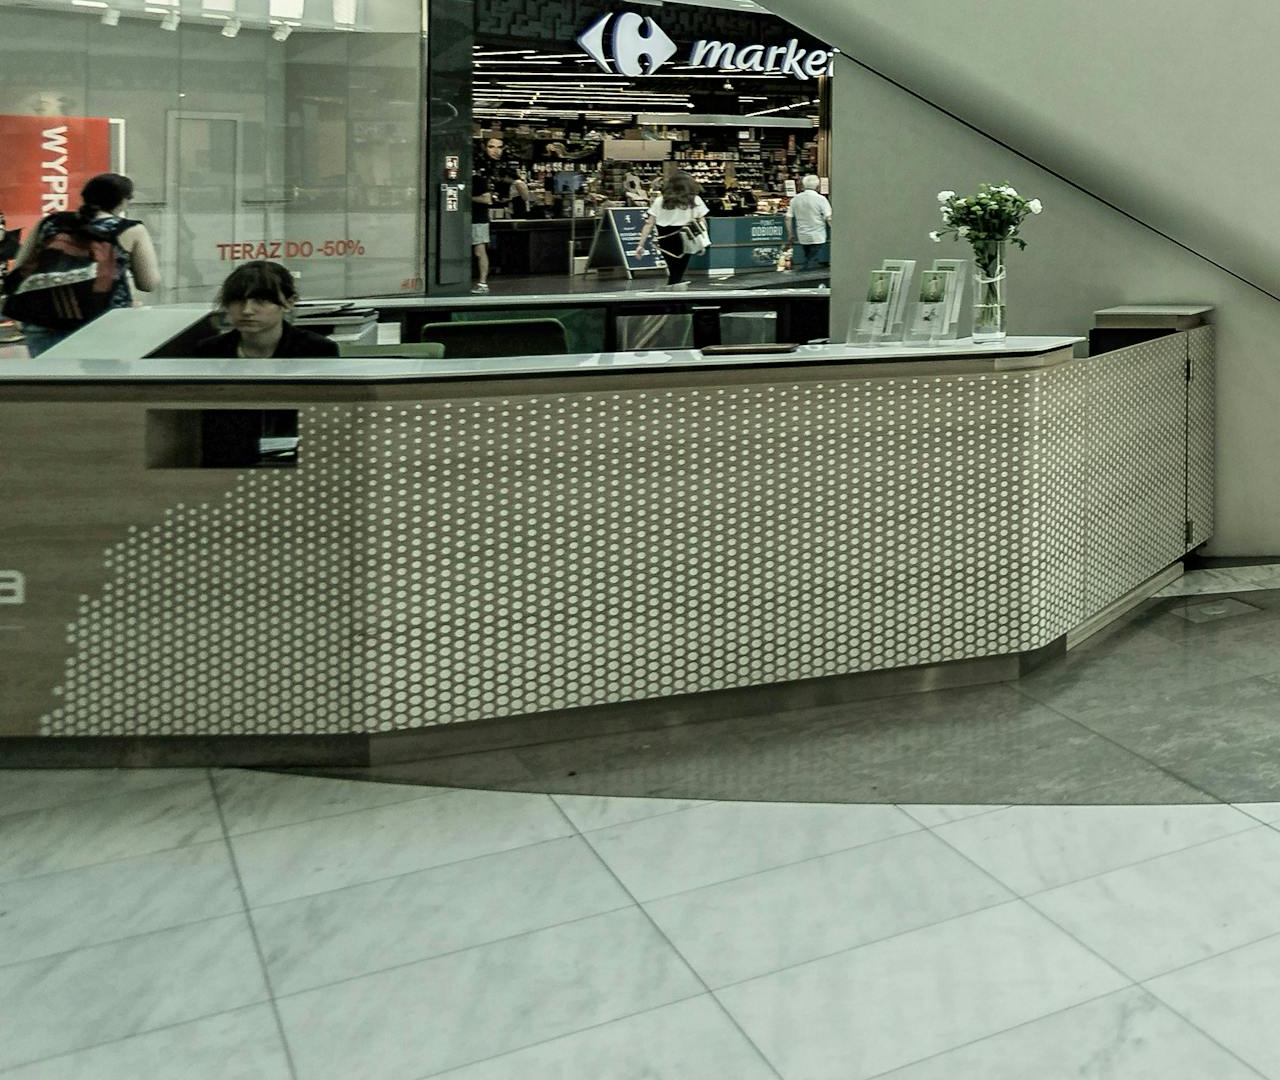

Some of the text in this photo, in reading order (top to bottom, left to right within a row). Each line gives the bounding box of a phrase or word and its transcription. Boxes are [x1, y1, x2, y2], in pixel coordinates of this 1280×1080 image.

[217, 240, 365, 261] TERAZ DO -50%
